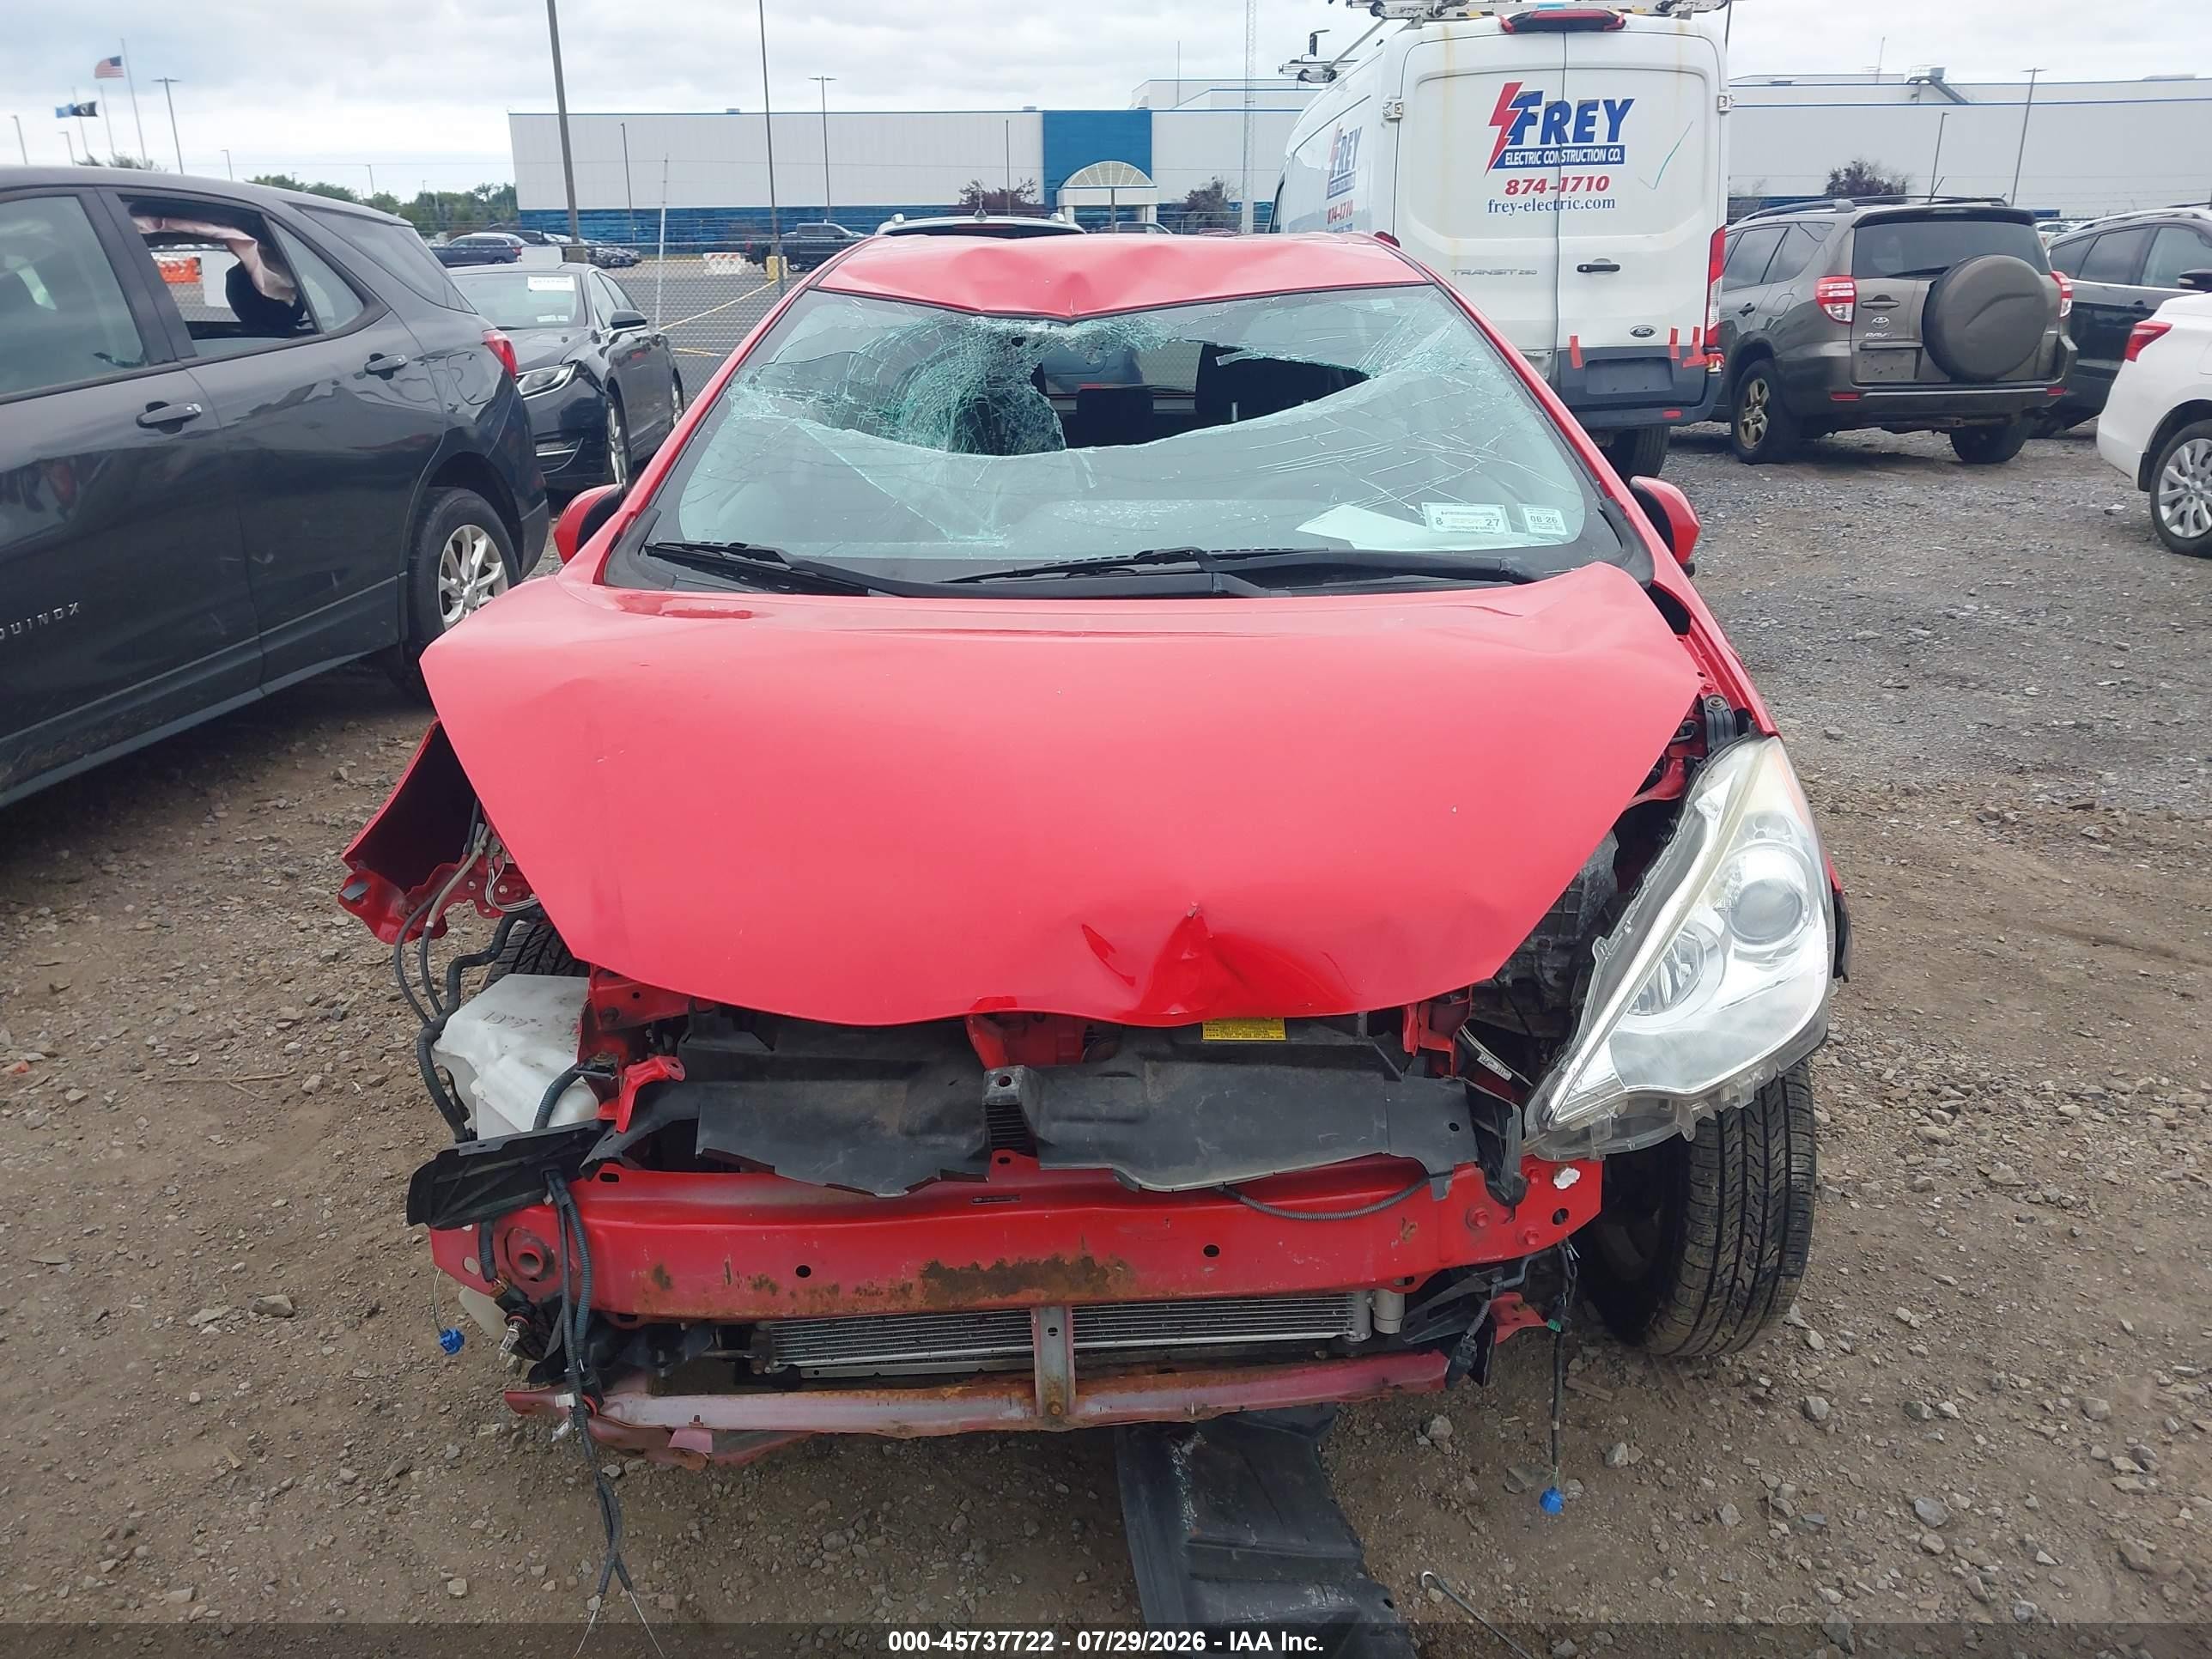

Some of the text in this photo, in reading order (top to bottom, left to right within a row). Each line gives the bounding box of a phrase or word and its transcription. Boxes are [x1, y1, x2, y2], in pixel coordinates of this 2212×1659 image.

[1508, 90, 1635, 145] FREY
[1331, 126, 1363, 179] FREY
[1505, 148, 1622, 166] ELECTRIC CONSTRUCTION CO.
[1504, 175, 1610, 196] 874-1710
[1487, 196, 1615, 216] frey-electric.com
[1485, 518, 1500, 527] 27
